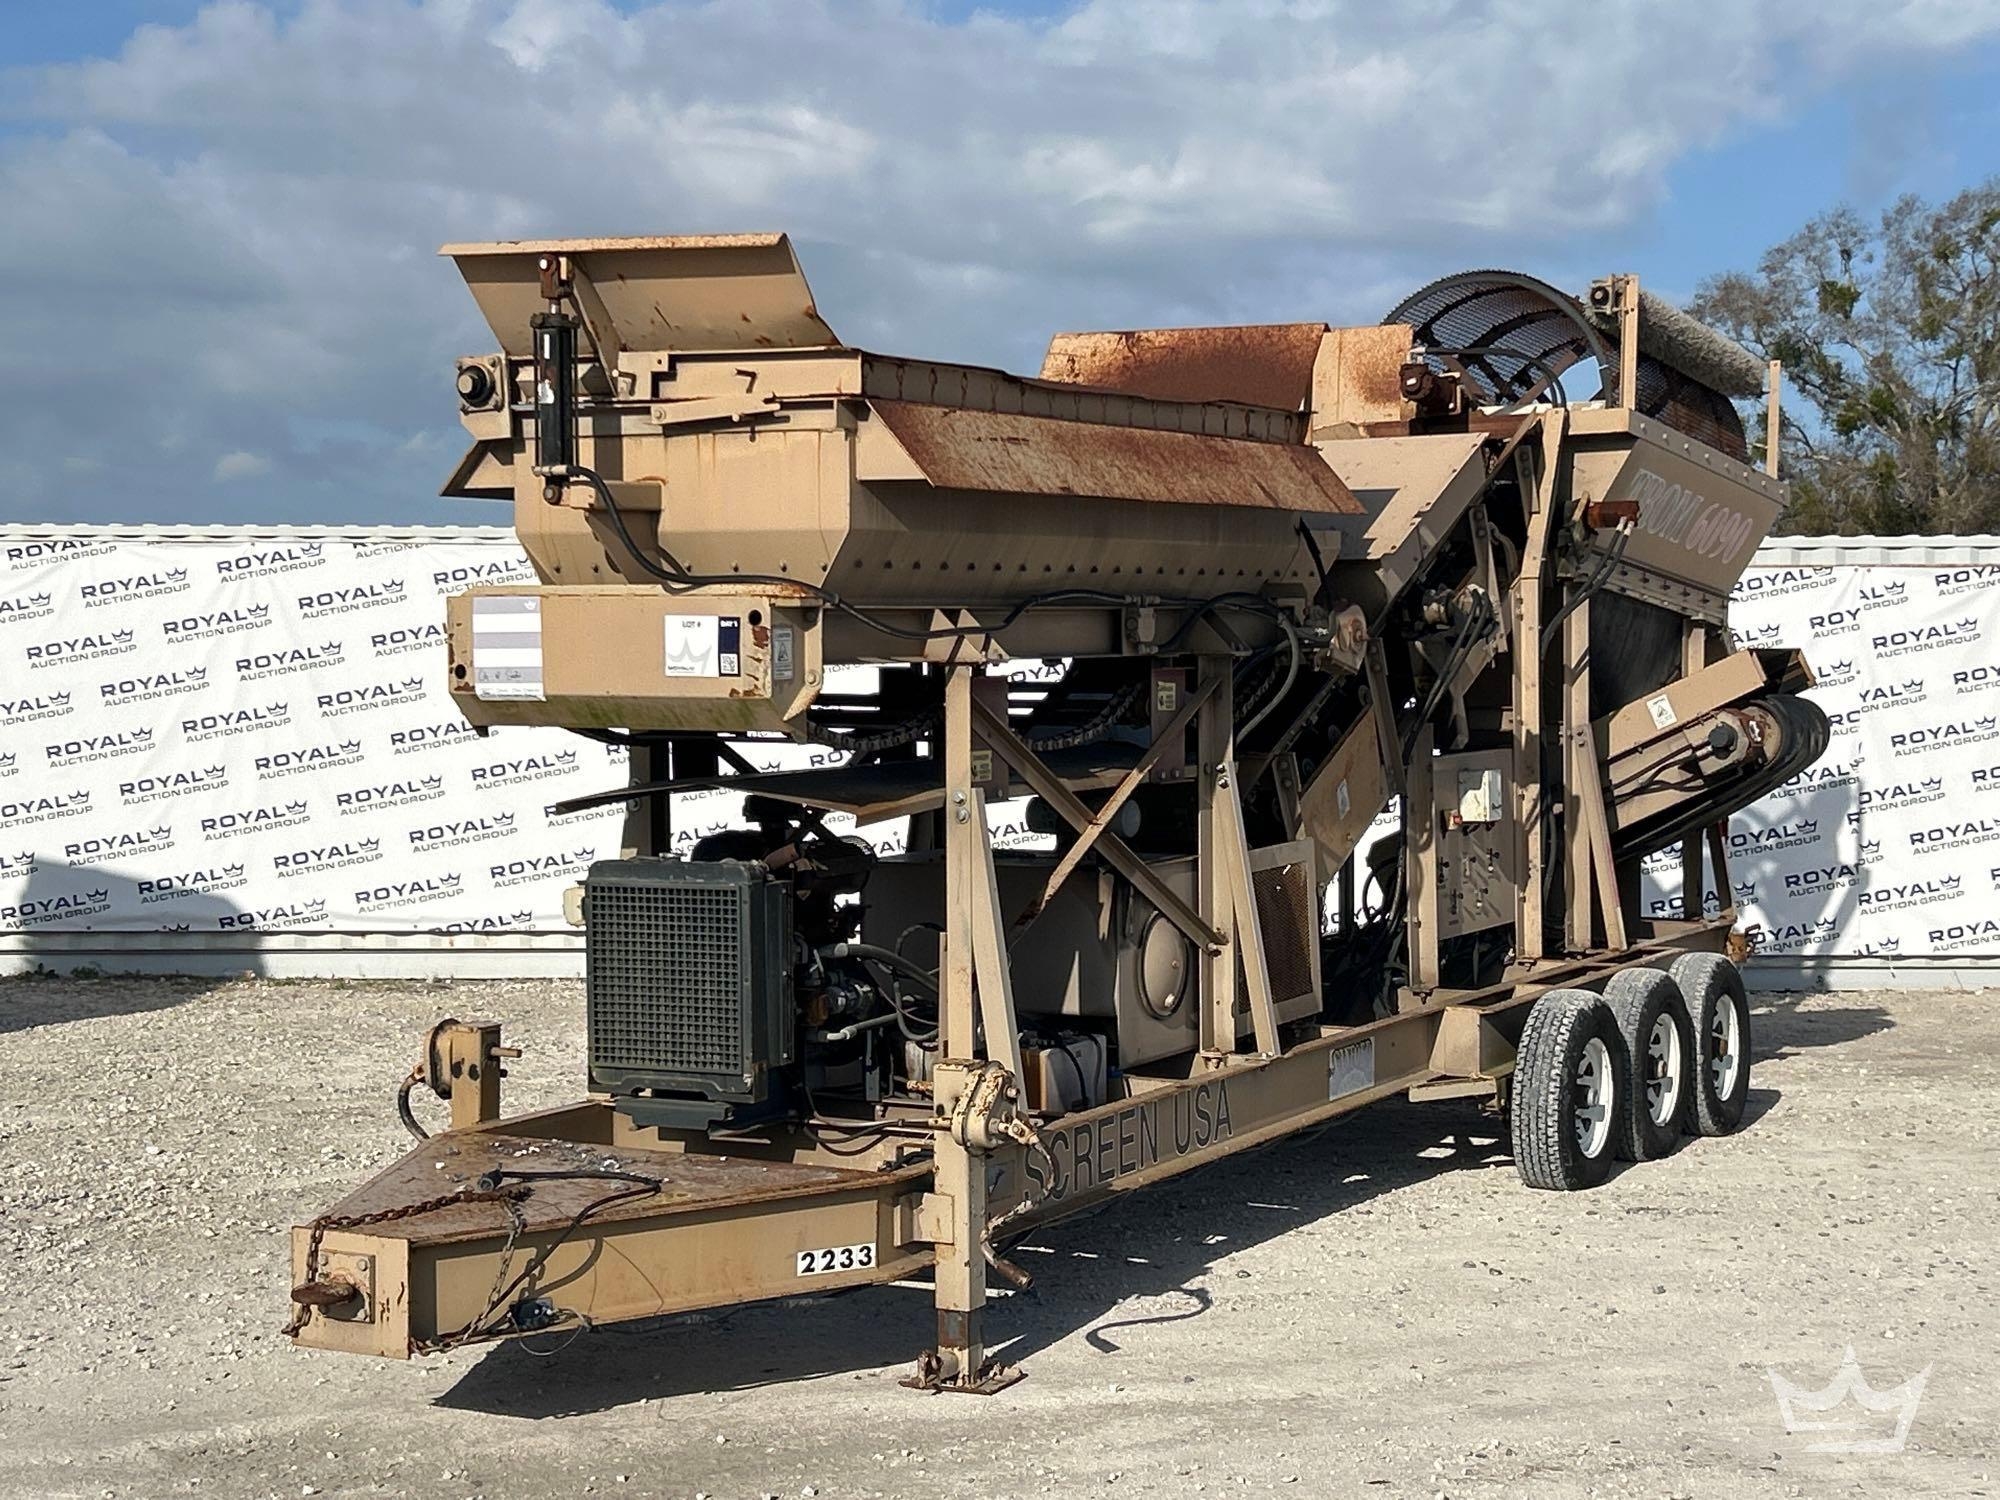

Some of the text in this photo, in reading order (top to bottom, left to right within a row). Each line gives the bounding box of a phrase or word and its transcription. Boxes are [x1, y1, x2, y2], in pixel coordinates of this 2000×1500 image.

[1685, 503, 1753, 564] 6090
[11, 545, 117, 571] AUCTION GROUP
[216, 549, 301, 574] ROYAL
[220, 558, 326, 583] AUCTION GROUP
[434, 561, 517, 585] ROYAL
[496, 571, 538, 584] GROU
[1791, 578, 1837, 592] GROUP
[81, 574, 166, 599] ROYAL
[85, 583, 191, 608] AUCTION GROUP
[298, 585, 383, 610] ROYAL
[1939, 579, 1996, 597] AUCTION
[9, 608, 55, 622] GROUP
[302, 594, 408, 619] AUCTION GROUP
[1863, 596, 1909, 611] GROUP
[163, 610, 248, 635] ROYAL
[167, 619, 273, 644] AUCTION GROUP
[1809, 608, 1860, 630] ROY
[1813, 623, 1860, 639] AUCTIO
[27, 635, 112, 660] ROYAL
[375, 641, 433, 657] AUCTION
[1872, 624, 1957, 650] ROYAL
[1876, 633, 1981, 659] AUCTION GROUP
[31, 644, 137, 669] AUCTION GROUP
[236, 648, 321, 673] ROYAL
[240, 657, 346, 682] AUCTION GROUP
[1953, 665, 2000, 685] ROY
[100, 673, 185, 698] ROYAL
[104, 682, 210, 707] AUCTION GROUP
[317, 684, 402, 709] ROYAL
[1860, 685, 1902, 703] YAL
[0, 697, 49, 715] YAL
[28, 706, 74, 721] GROUP
[321, 693, 427, 718] AUCTION GROUP
[1882, 694, 1927, 709] GROUP
[182, 708, 267, 733] ROYAL
[186, 717, 292, 742] AUCTION GROUP
[391, 721, 474, 746] ROYAL
[394, 729, 499, 755] AUCTION GROP
[1890, 722, 1975, 748] ROYAL
[1894, 731, 1999, 757] AUCTION GROUP
[46, 734, 131, 759] ROYAL
[50, 743, 156, 768] AUCTION GROUP
[255, 746, 340, 771] ROYAL
[259, 755, 365, 780] AUCTION GROUP
[471, 756, 556, 781] ROYAL
[475, 765, 581, 790] AUCTION GROUP
[1784, 764, 1850, 786] OYAL
[119, 771, 204, 796] ROYAL
[123, 780, 229, 805] AUCTION GROUP
[336, 782, 421, 807] ROYAL
[1769, 783, 1827, 800] AUCTION
[1860, 783, 1921, 805] OYAL
[1, 796, 68, 817] OYAL
[47, 804, 94, 820] GROUP
[340, 791, 446, 816] AUCTION GROUP
[1860, 792, 1946, 815] CTION GROUP
[201, 807, 286, 832] ROYAL
[205, 816, 311, 841] AUCTION GROUP
[409, 819, 494, 844] ROYAL
[547, 811, 604, 828] AUCTION
[65, 832, 150, 857] ROYAL
[413, 828, 519, 853] AUCTION GROUP
[1730, 826, 1797, 848] OYAL
[1775, 835, 1821, 849] GROUP
[1910, 820, 1994, 845] ROYAL
[69, 841, 175, 866] AUCTION GROUP
[274, 844, 359, 869] ROYAL
[1913, 839, 1970, 856] AUCTION
[0, 866, 38, 880] ROUP
[278, 853, 384, 878] AUCTION GROUP
[490, 853, 574, 878] ROYAL
[494, 864, 590, 888] AUCTION GROU
[1785, 864, 1860, 888] ROYA
[138, 870, 223, 895] ROYAL
[142, 879, 248, 904] AUCTION GROUP
[355, 879, 440, 904] ROYAL
[1788, 880, 1846, 898] AUCTION
[1858, 881, 1943, 907] ROYAL
[2, 895, 87, 920] ROYAL
[359, 888, 465, 913] AUCTION GROUP
[1862, 890, 1967, 916] AUCTION GROUP
[6, 904, 112, 929] AUCTION GROUP
[219, 904, 303, 929] ROYAL
[283, 913, 329, 927] GROUP
[1795, 931, 1841, 947] GROUP
[1928, 920, 2000, 942] ROYA
[1933, 936, 1989, 952] AUCTION
[1174, 1079, 1233, 1156] USA
[801, 1245, 872, 1273] 2233
